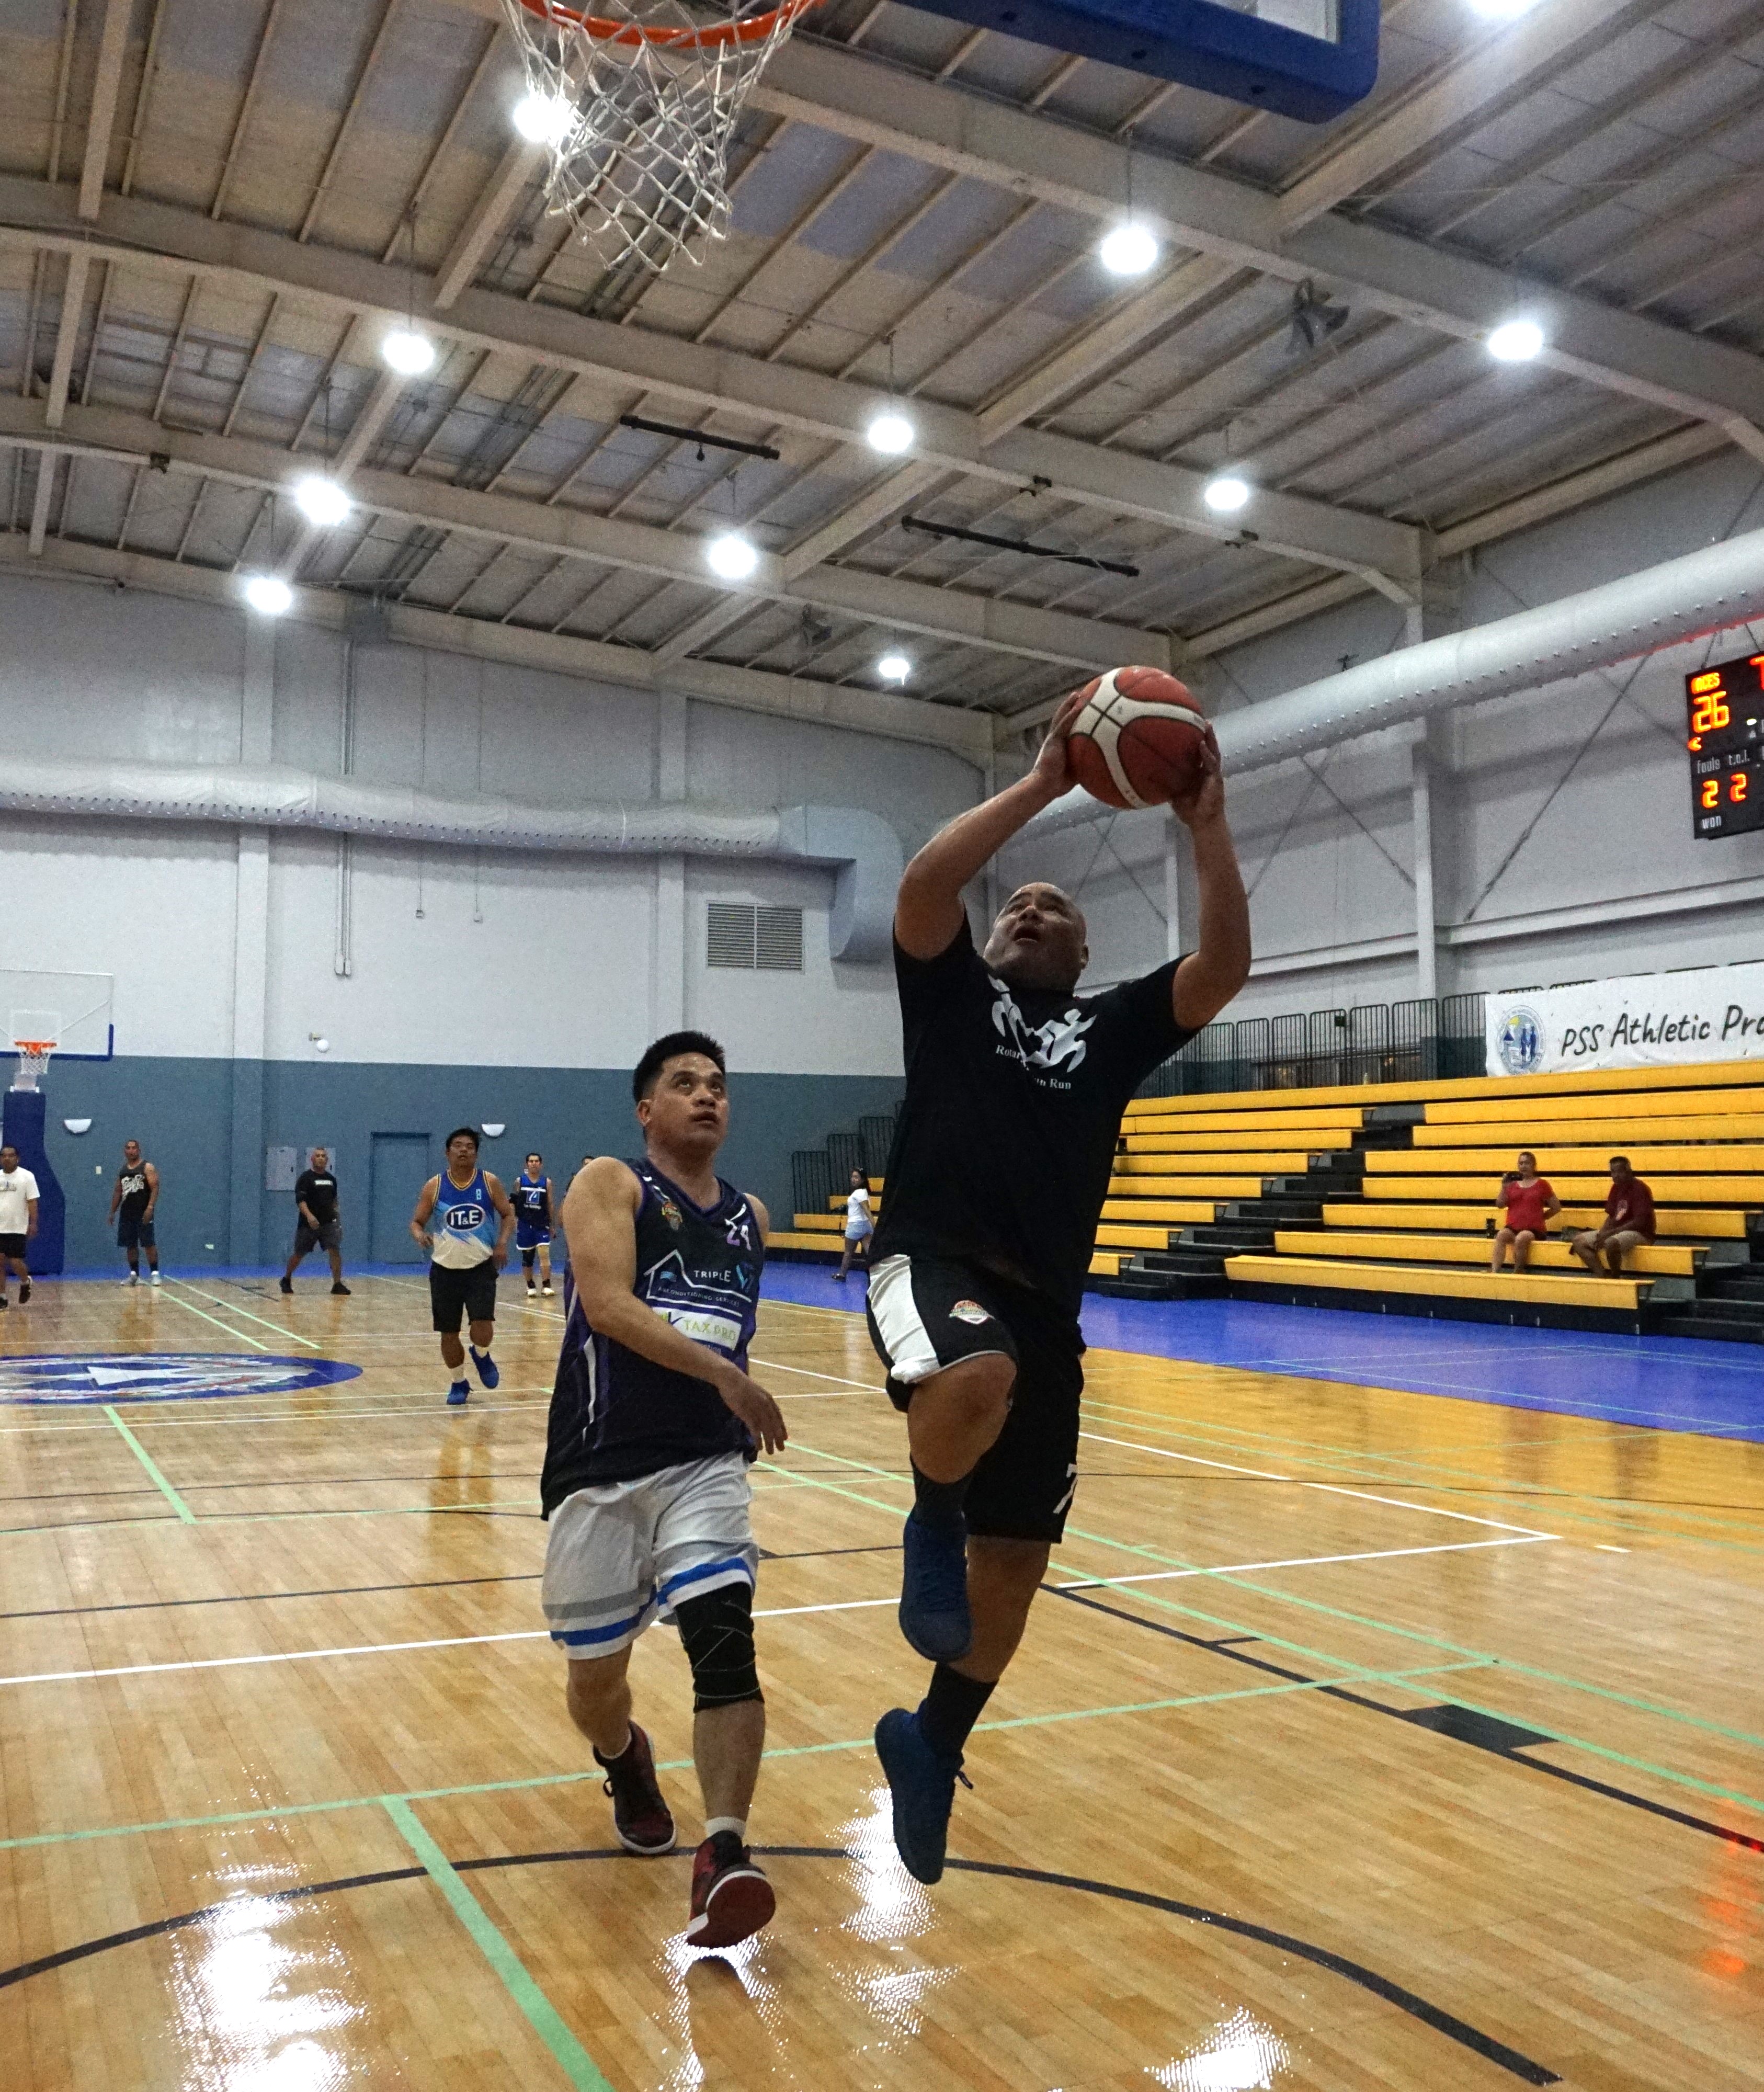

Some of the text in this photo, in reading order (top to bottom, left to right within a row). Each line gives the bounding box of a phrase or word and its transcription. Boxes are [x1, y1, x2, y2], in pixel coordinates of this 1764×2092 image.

[1693, 691, 1729, 732] 26
[1702, 774, 1747, 808] 2 2
[1702, 815, 1722, 829] won
[1561, 1024, 1604, 1056] PSS
[1611, 1012, 1710, 1048] Athletic
[1050, 1078, 1071, 1089] Run
[450, 1210, 479, 1226] IT&E
[693, 1270, 731, 1282] TRIPLE
